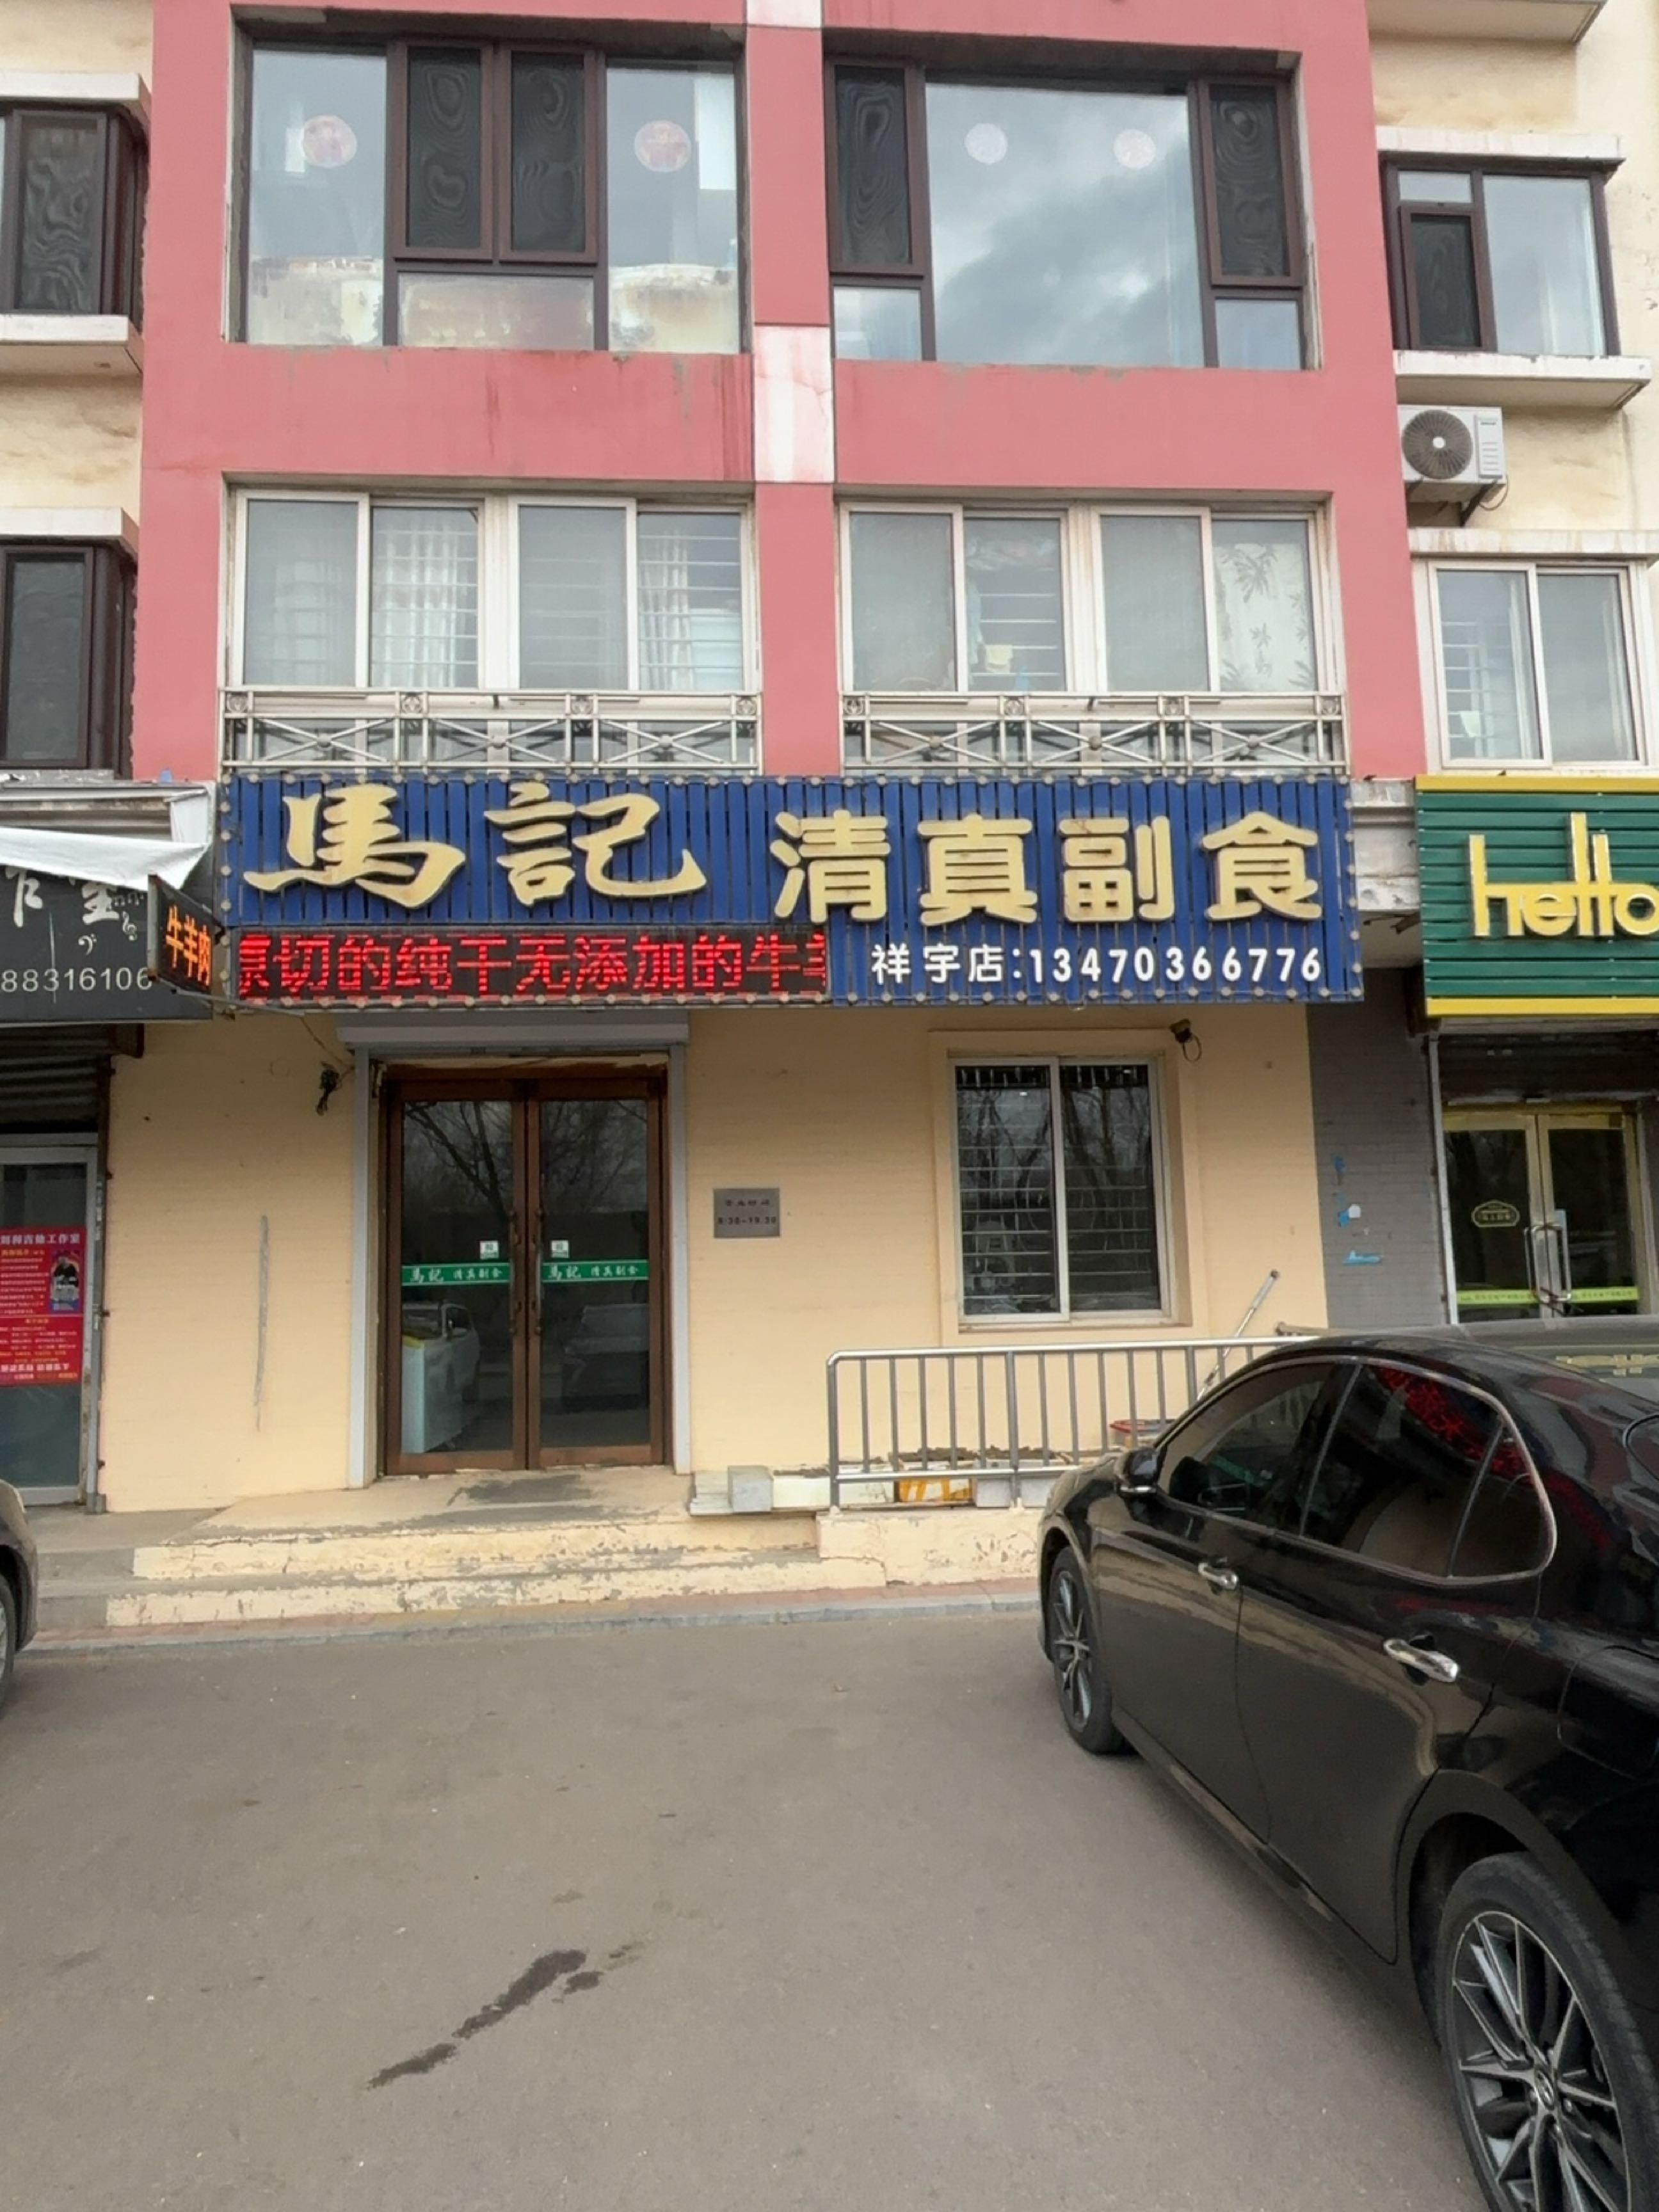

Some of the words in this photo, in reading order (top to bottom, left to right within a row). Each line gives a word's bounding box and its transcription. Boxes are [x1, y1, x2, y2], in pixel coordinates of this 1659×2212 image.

[244, 783, 706, 908] 馬記
[770, 809, 1322, 926] 清真副食
[1469, 812, 1659, 936] hello
[166, 904, 211, 986] 牛羊肉
